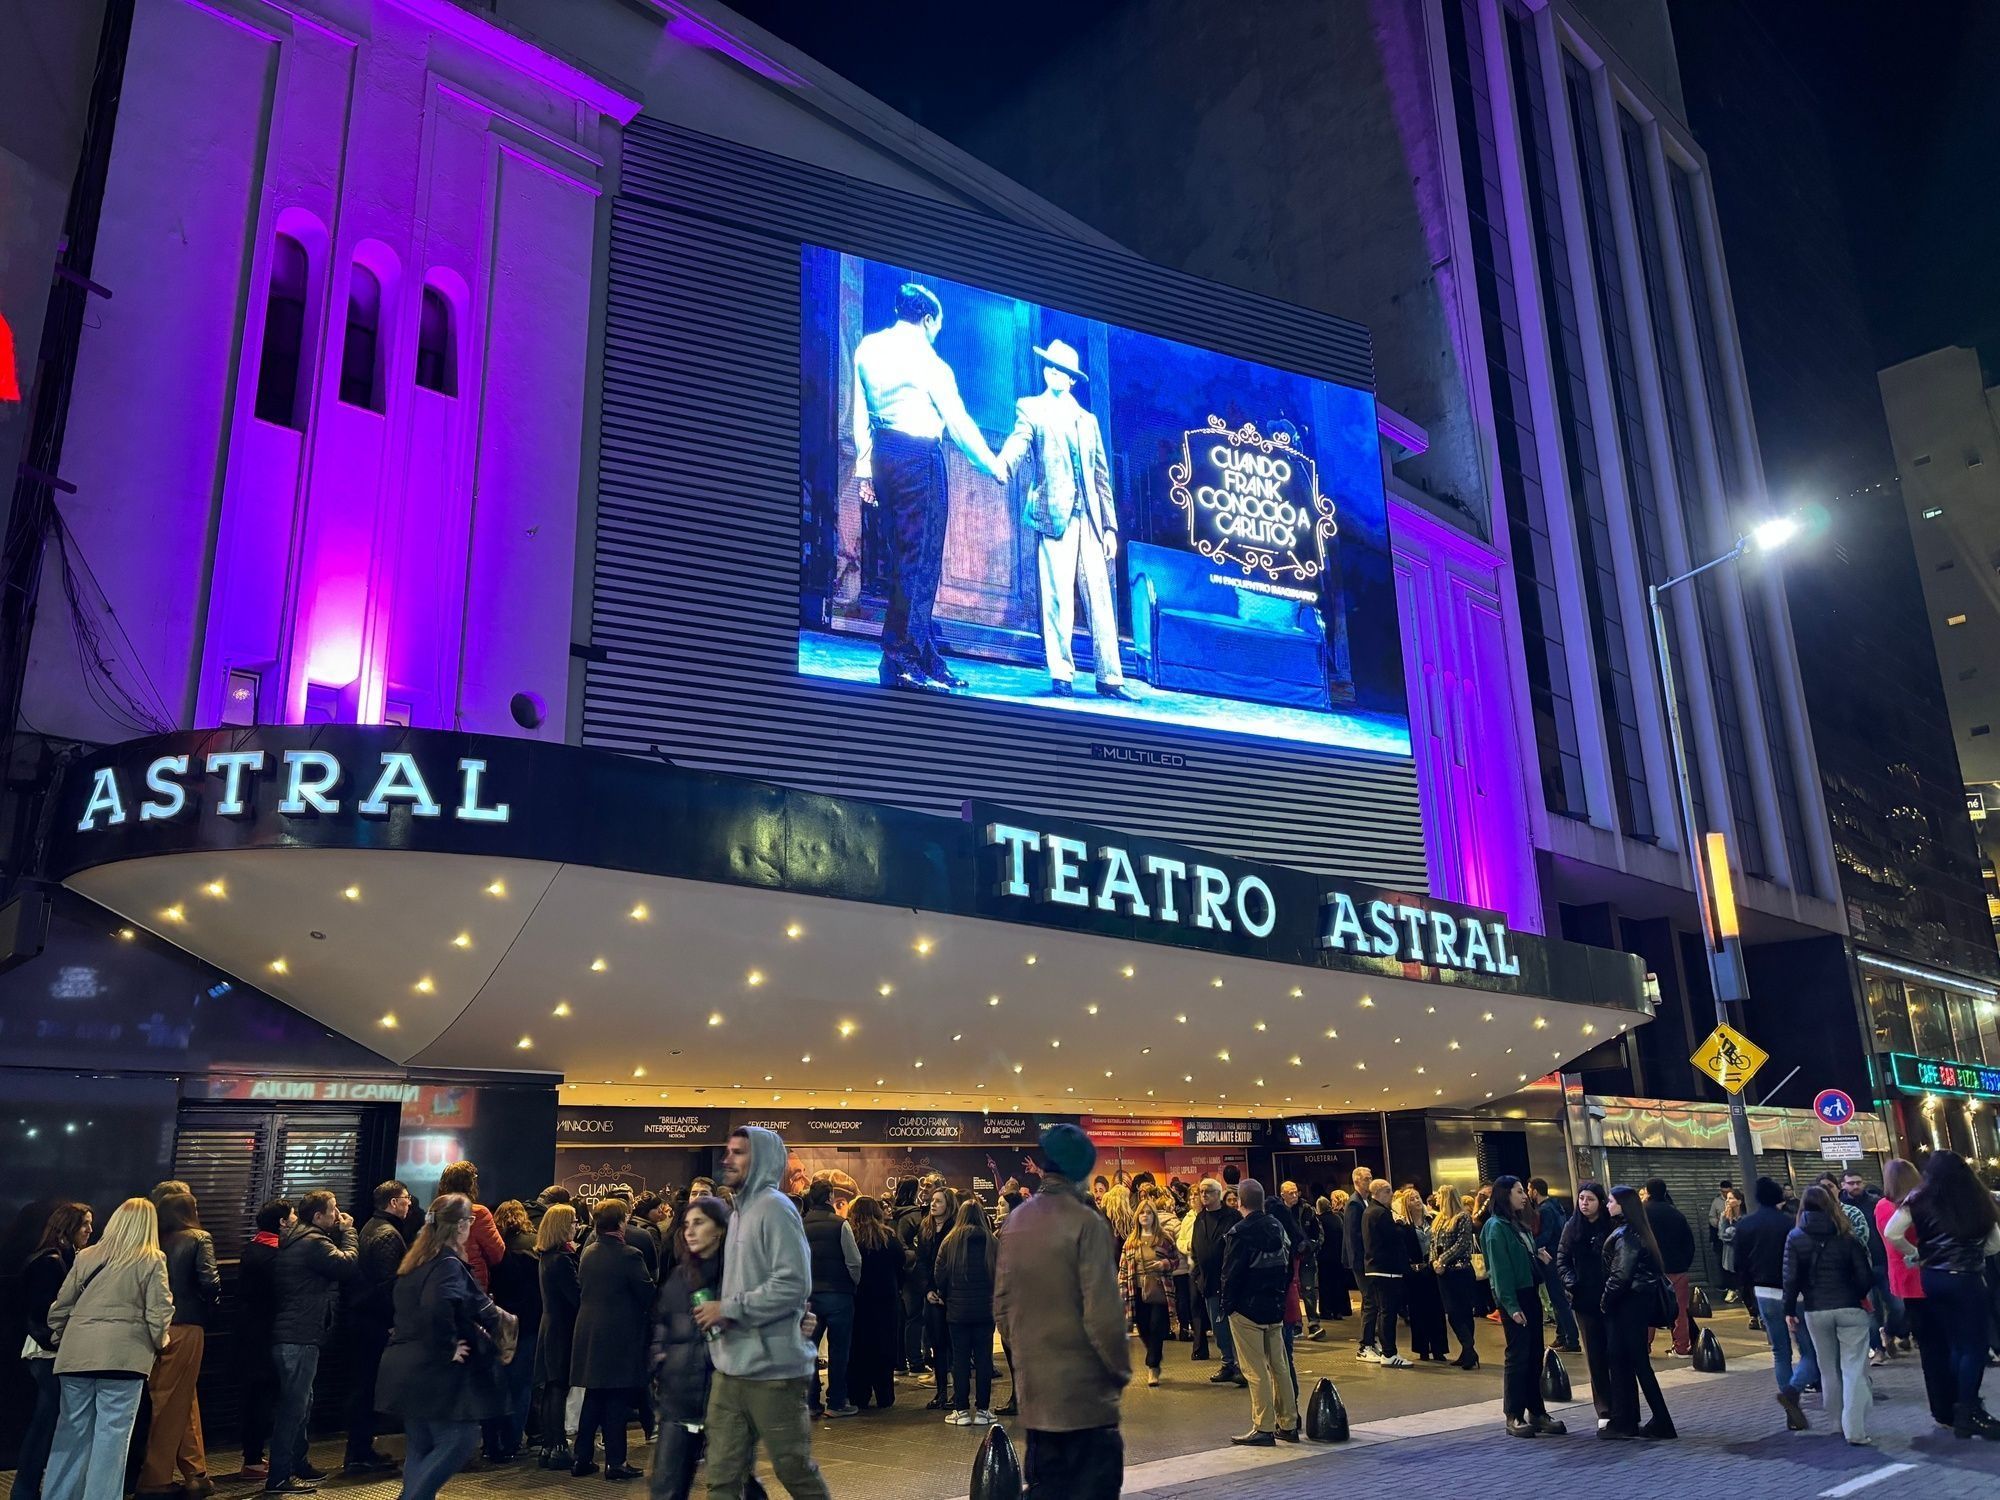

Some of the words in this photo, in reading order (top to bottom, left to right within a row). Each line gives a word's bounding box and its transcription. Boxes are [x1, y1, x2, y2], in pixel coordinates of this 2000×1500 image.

[1210, 445, 1292, 482] CUANDO
[1223, 469, 1283, 501] FRANK
[1197, 485, 1297, 525] CONOCIÓ
[1298, 507, 1311, 529] A
[1215, 511, 1297, 547] CARLITOS
[1209, 573, 1222, 585] UN
[1223, 576, 1271, 594] ENCUENTRO
[1103, 746, 1184, 767] MULTILED
[77, 749, 510, 832] ASTRAL
[987, 822, 1277, 938] TEATRO
[1326, 891, 1521, 977] ASTRAL
[1940, 1066, 1956, 1087] BAR
[1957, 1069, 1980, 1089] PIZZA
[556, 1119, 614, 1133] MINACIONES
[898, 1116, 928, 1127] CUANDO
[928, 1117, 949, 1127] FRANK
[925, 1127, 930, 1136] A
[930, 1127, 959, 1137] CARLITOS
[983, 1126, 992, 1134] LO
[1196, 1130, 1234, 1144] ¡DESOPILANTE
[1234, 1129, 1253, 1143] ÉXITO!
[1304, 1155, 1338, 1163] BOLETERIA
